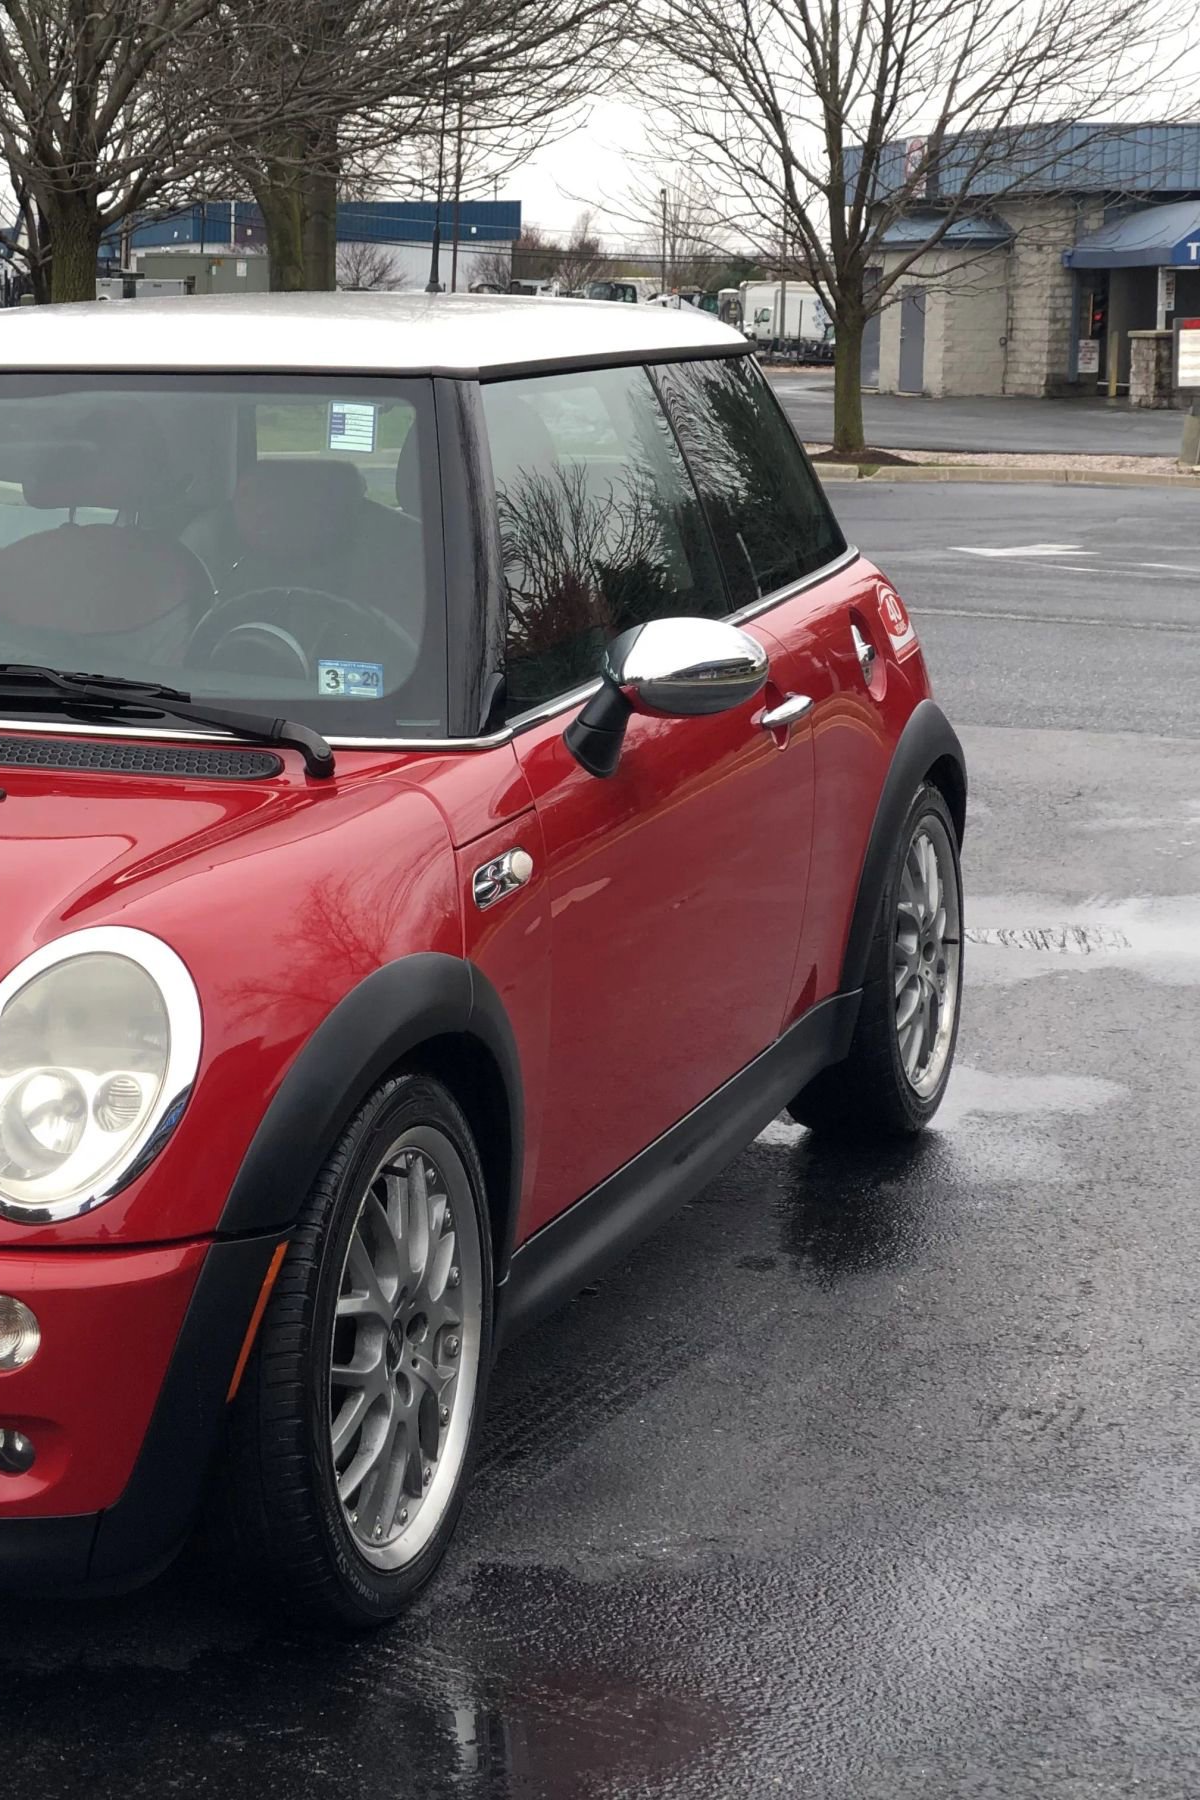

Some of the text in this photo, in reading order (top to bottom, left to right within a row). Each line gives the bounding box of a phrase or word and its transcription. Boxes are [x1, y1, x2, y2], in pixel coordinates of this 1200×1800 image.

[885, 594, 903, 623] 40
[325, 669, 380, 689] 3 20
